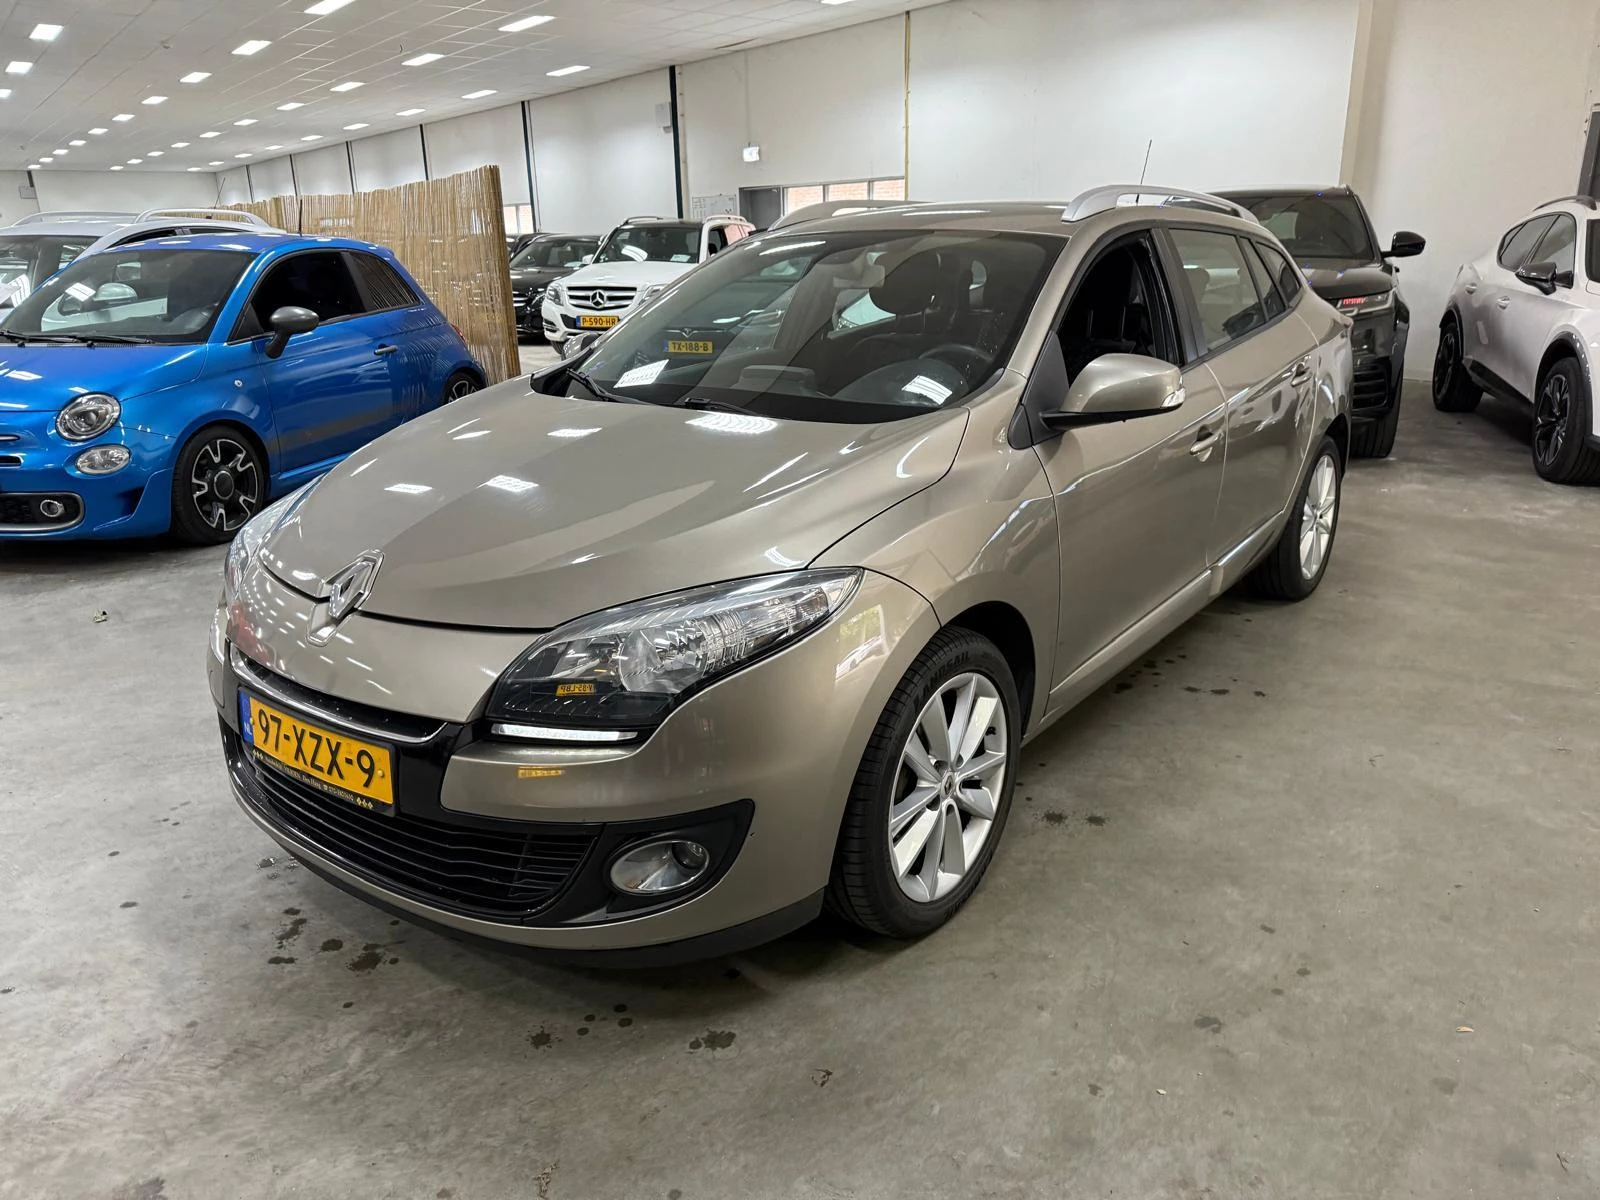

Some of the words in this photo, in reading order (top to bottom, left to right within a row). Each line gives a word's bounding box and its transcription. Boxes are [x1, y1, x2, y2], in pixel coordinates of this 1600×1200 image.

[582, 317, 616, 326] P-590-HR
[672, 342, 709, 351] TX-188-B
[258, 708, 375, 788] 97-XZX-9
